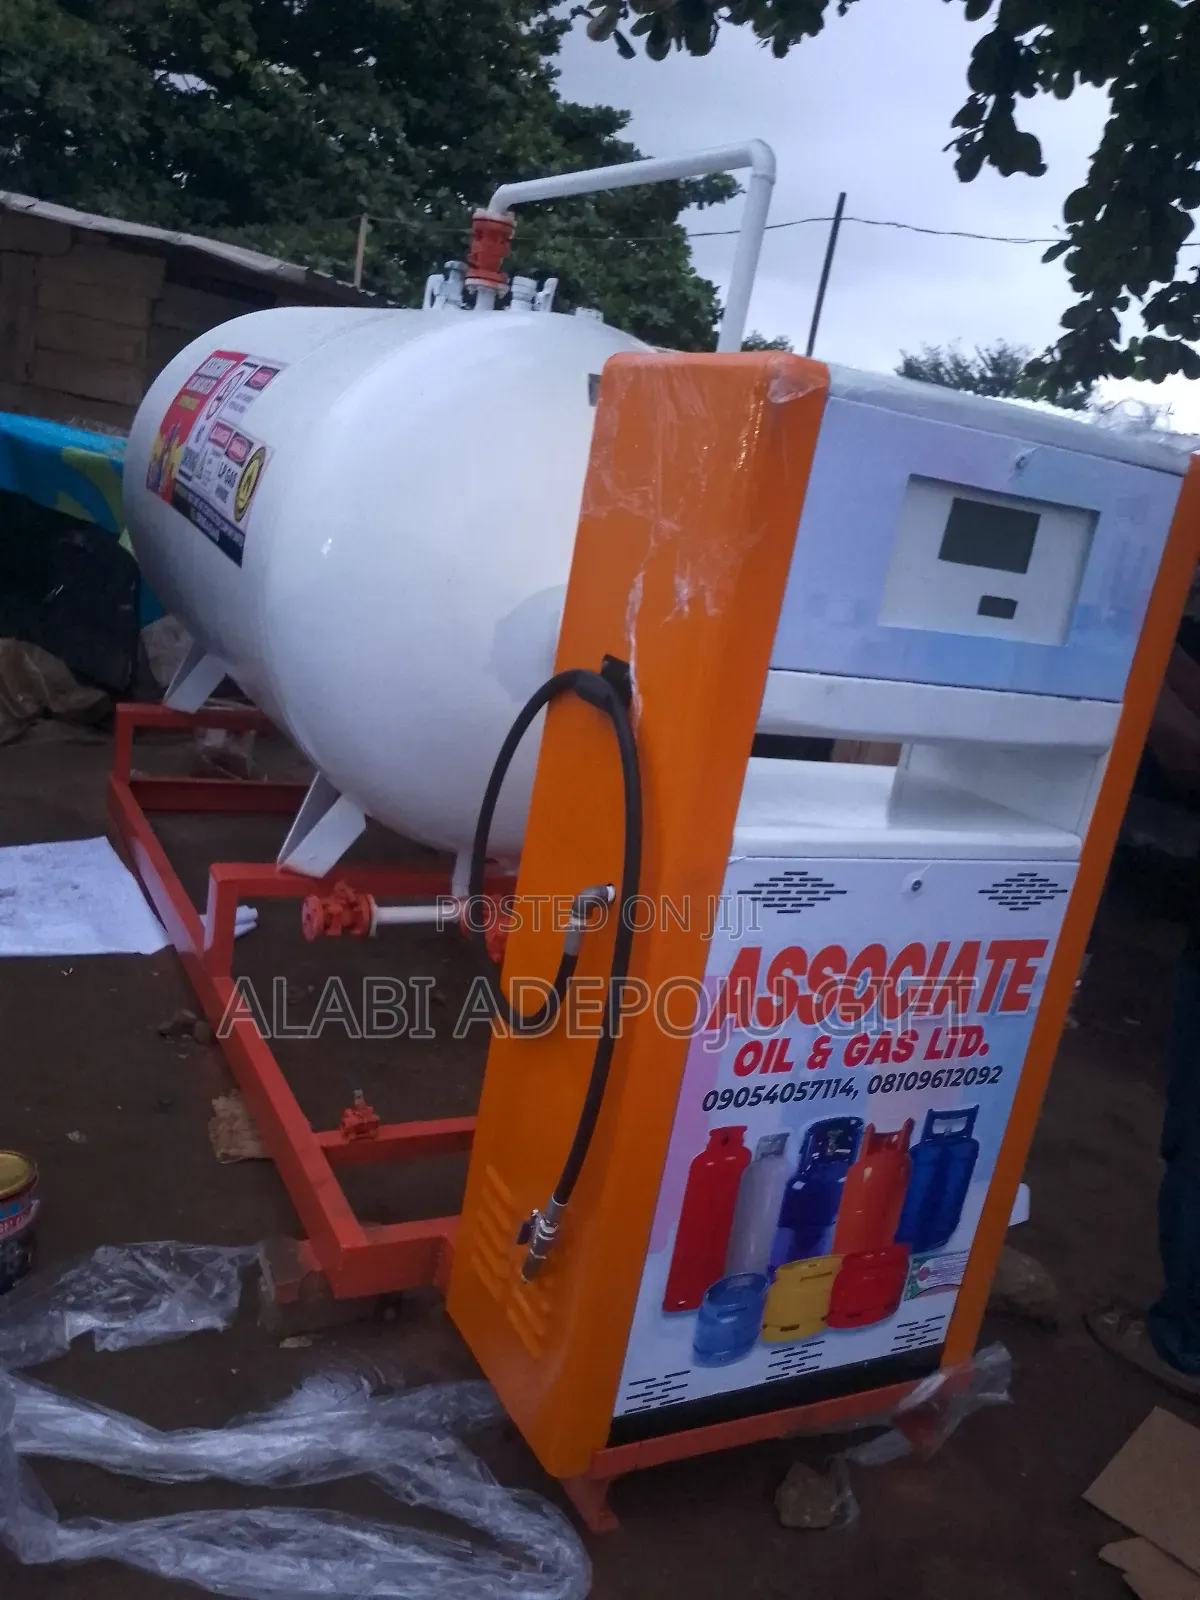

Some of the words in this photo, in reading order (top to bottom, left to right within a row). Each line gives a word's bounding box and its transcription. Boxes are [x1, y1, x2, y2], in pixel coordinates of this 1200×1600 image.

[706, 939, 1048, 1030] ASSOCIATE
[732, 1036, 793, 1077] OIL
[806, 1034, 833, 1070] &
[843, 1029, 918, 1067] GAS
[924, 1025, 989, 1060] LTD.
[702, 1077, 859, 1112] 09054057114,
[867, 1065, 1003, 1096] 08109612092
